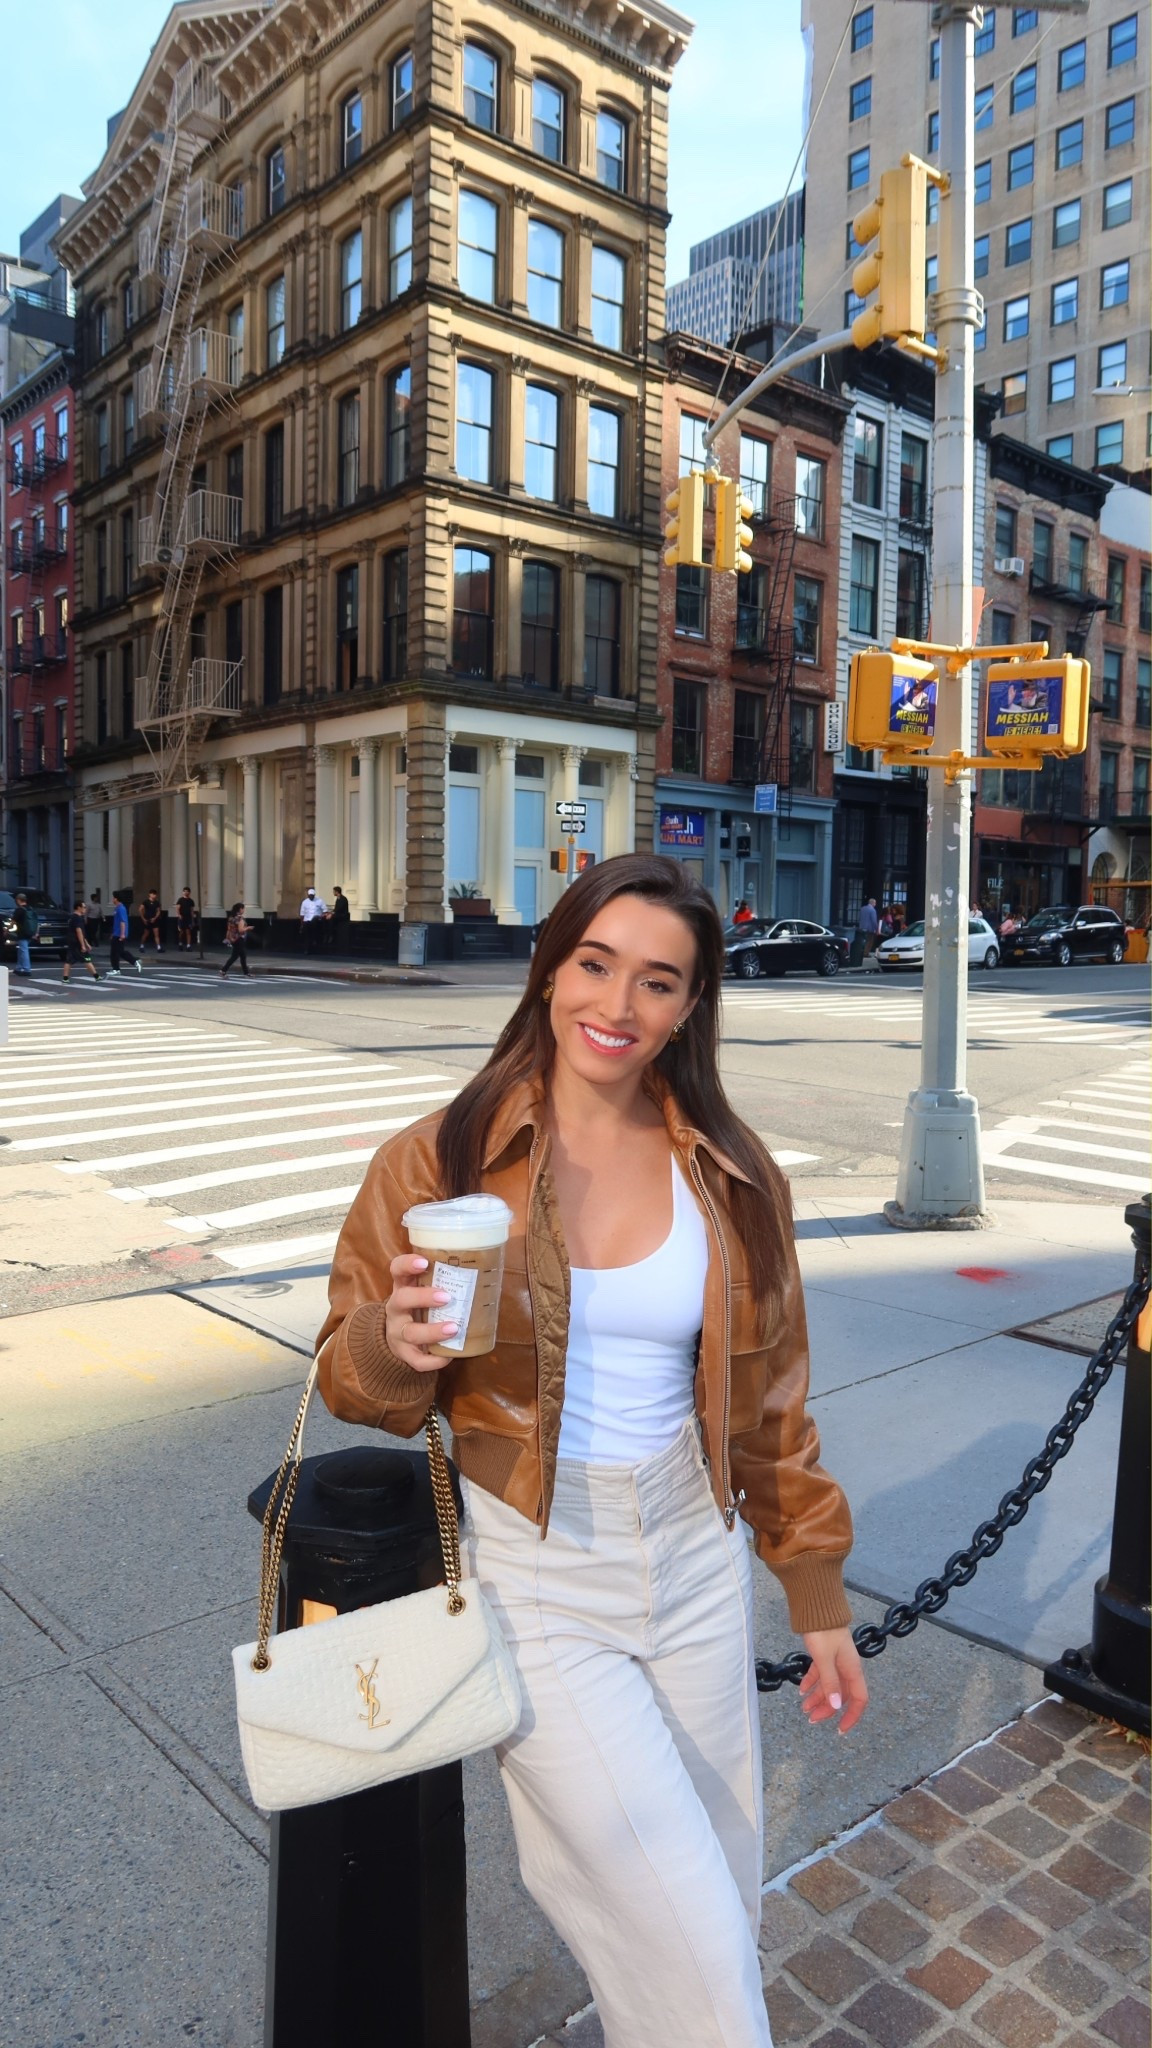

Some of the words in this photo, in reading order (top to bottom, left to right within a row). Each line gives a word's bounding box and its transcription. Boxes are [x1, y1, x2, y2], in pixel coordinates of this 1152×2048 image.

[896, 710, 928, 723] MESSIAH
[995, 711, 1049, 725] MESSIAH
[828, 703, 839, 749] BURLESQUE
[1005, 727, 1014, 735] IS
[1016, 726, 1041, 735] HERE!
[677, 834, 704, 845] MART
[355, 1658, 391, 1729] YSL
